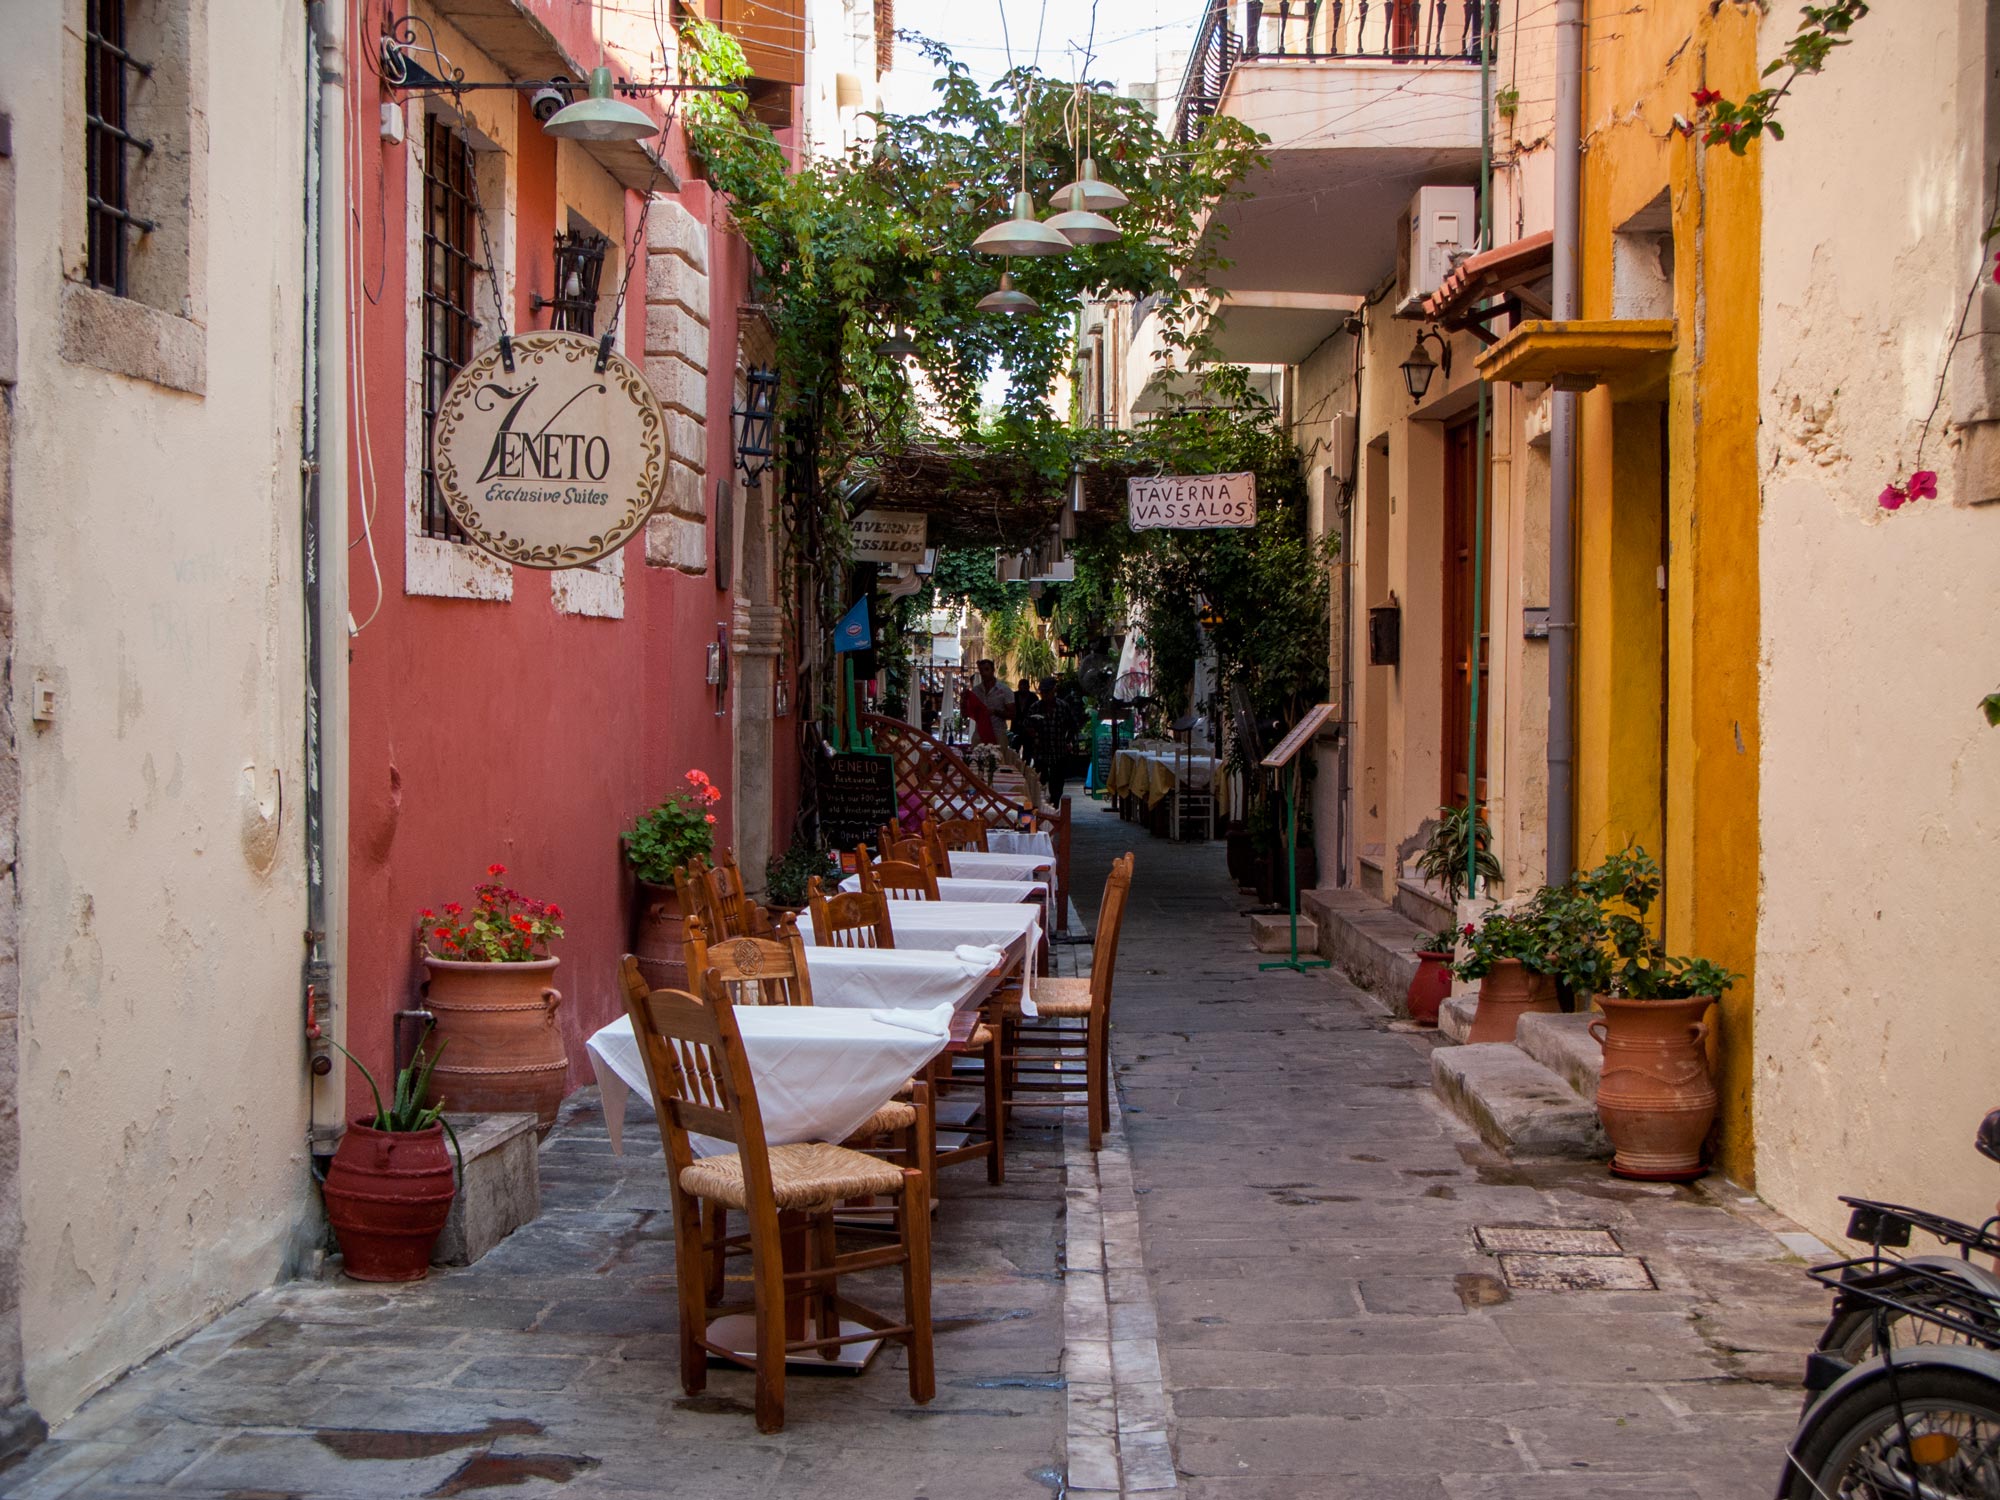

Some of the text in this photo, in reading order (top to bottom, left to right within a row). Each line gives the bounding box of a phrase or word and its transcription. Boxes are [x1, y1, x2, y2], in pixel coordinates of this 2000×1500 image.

[475, 383, 610, 484] VENETO
[485, 483, 609, 506] Exclusive Suites
[1136, 484, 1231, 502] TAVERNA
[1136, 502, 1248, 520] VASSALOS
[850, 521, 921, 535] AVERNA
[853, 539, 922, 553] ASSALOS
